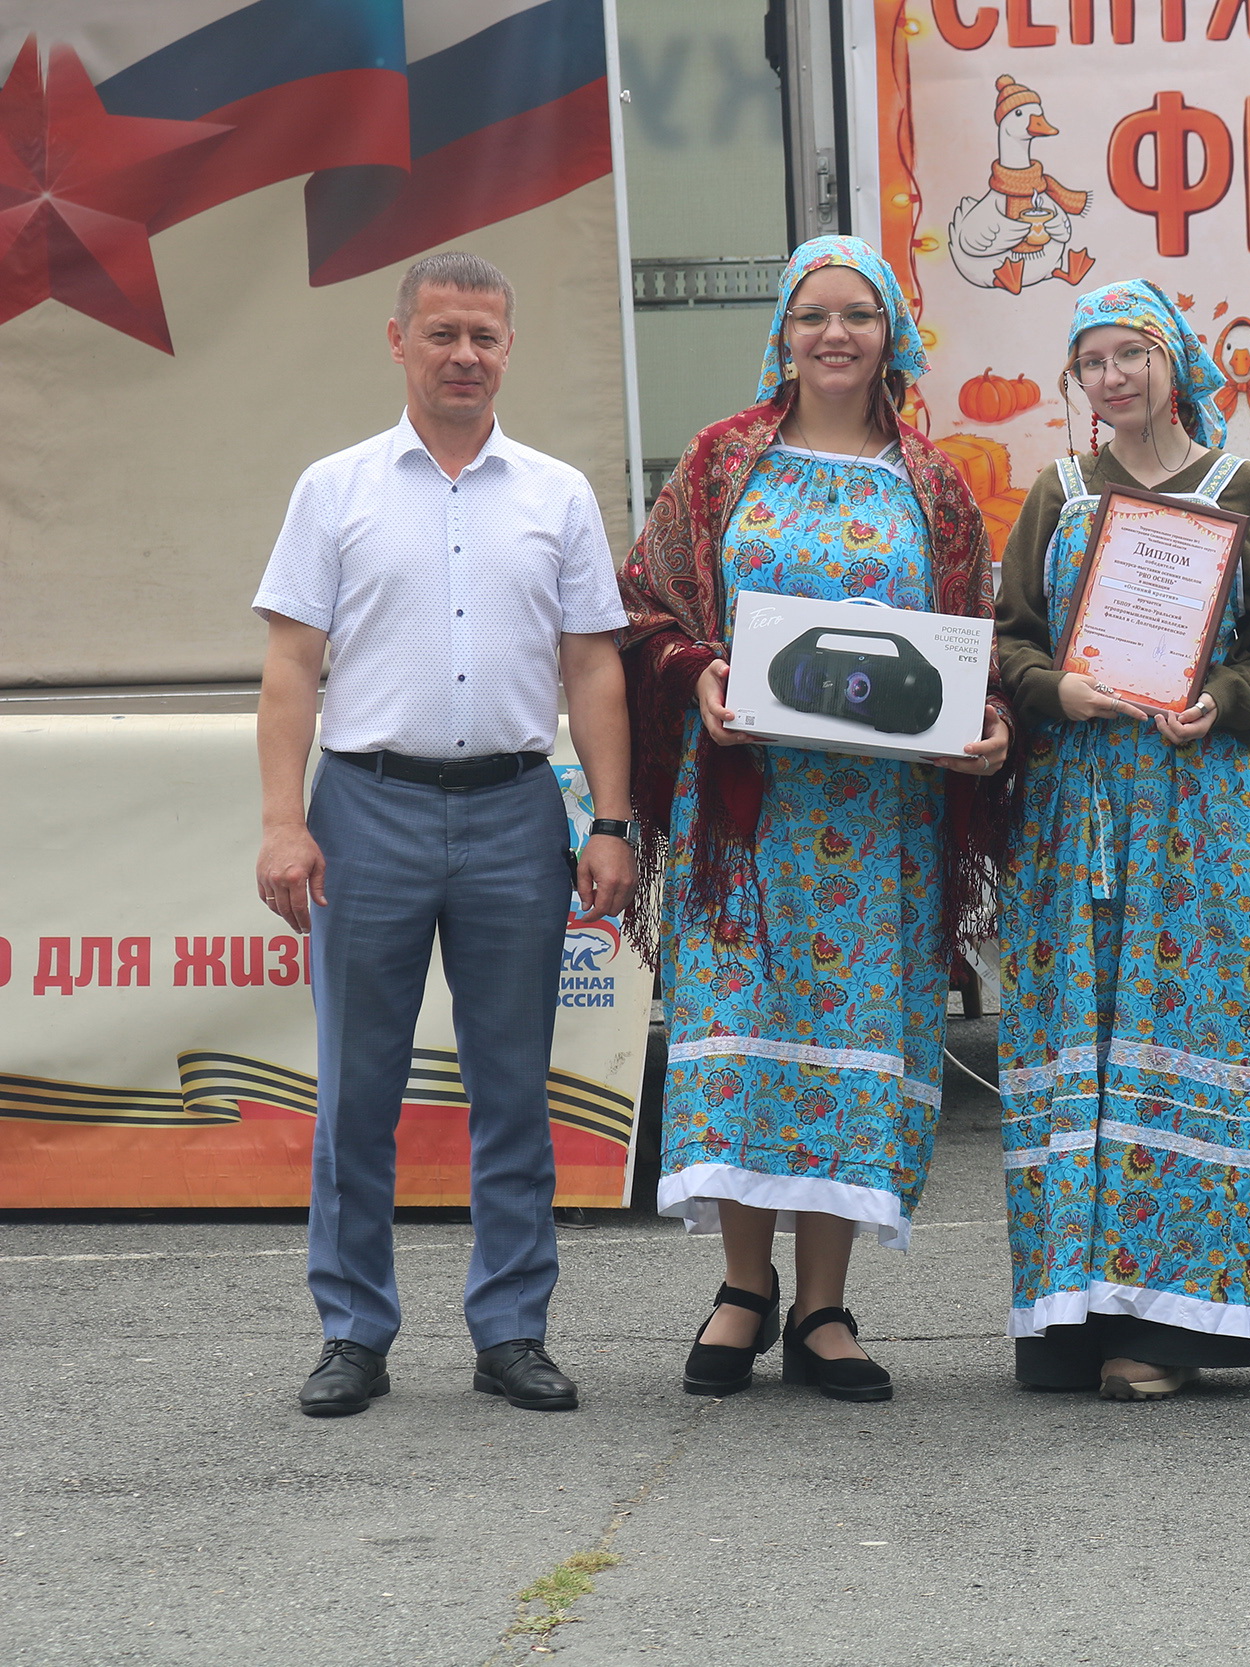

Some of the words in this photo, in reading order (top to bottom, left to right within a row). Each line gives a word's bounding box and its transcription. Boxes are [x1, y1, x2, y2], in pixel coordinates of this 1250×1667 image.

[1133, 541, 1190, 567] Диплом
[1144, 558, 1175, 569] победителя
[1142, 581, 1170, 590] номинации
[1137, 598, 1161, 607] вручается
[748, 606, 785, 630] Fiero
[1104, 604, 1160, 622] агропромышленный
[1104, 611, 1125, 621] филиал
[1135, 620, 1186, 636] Долгодеревенское
[942, 626, 980, 636] PORTABLE
[934, 634, 979, 646] BLUETOOTH
[944, 644, 978, 654] SPEAKER
[958, 655, 978, 663] EYES
[33, 936, 151, 996] ДЛЯ
[173, 935, 311, 987] ЖИЗ
[561, 976, 614, 990] ИНАЯ
[556, 994, 614, 1007] ССИЯ
